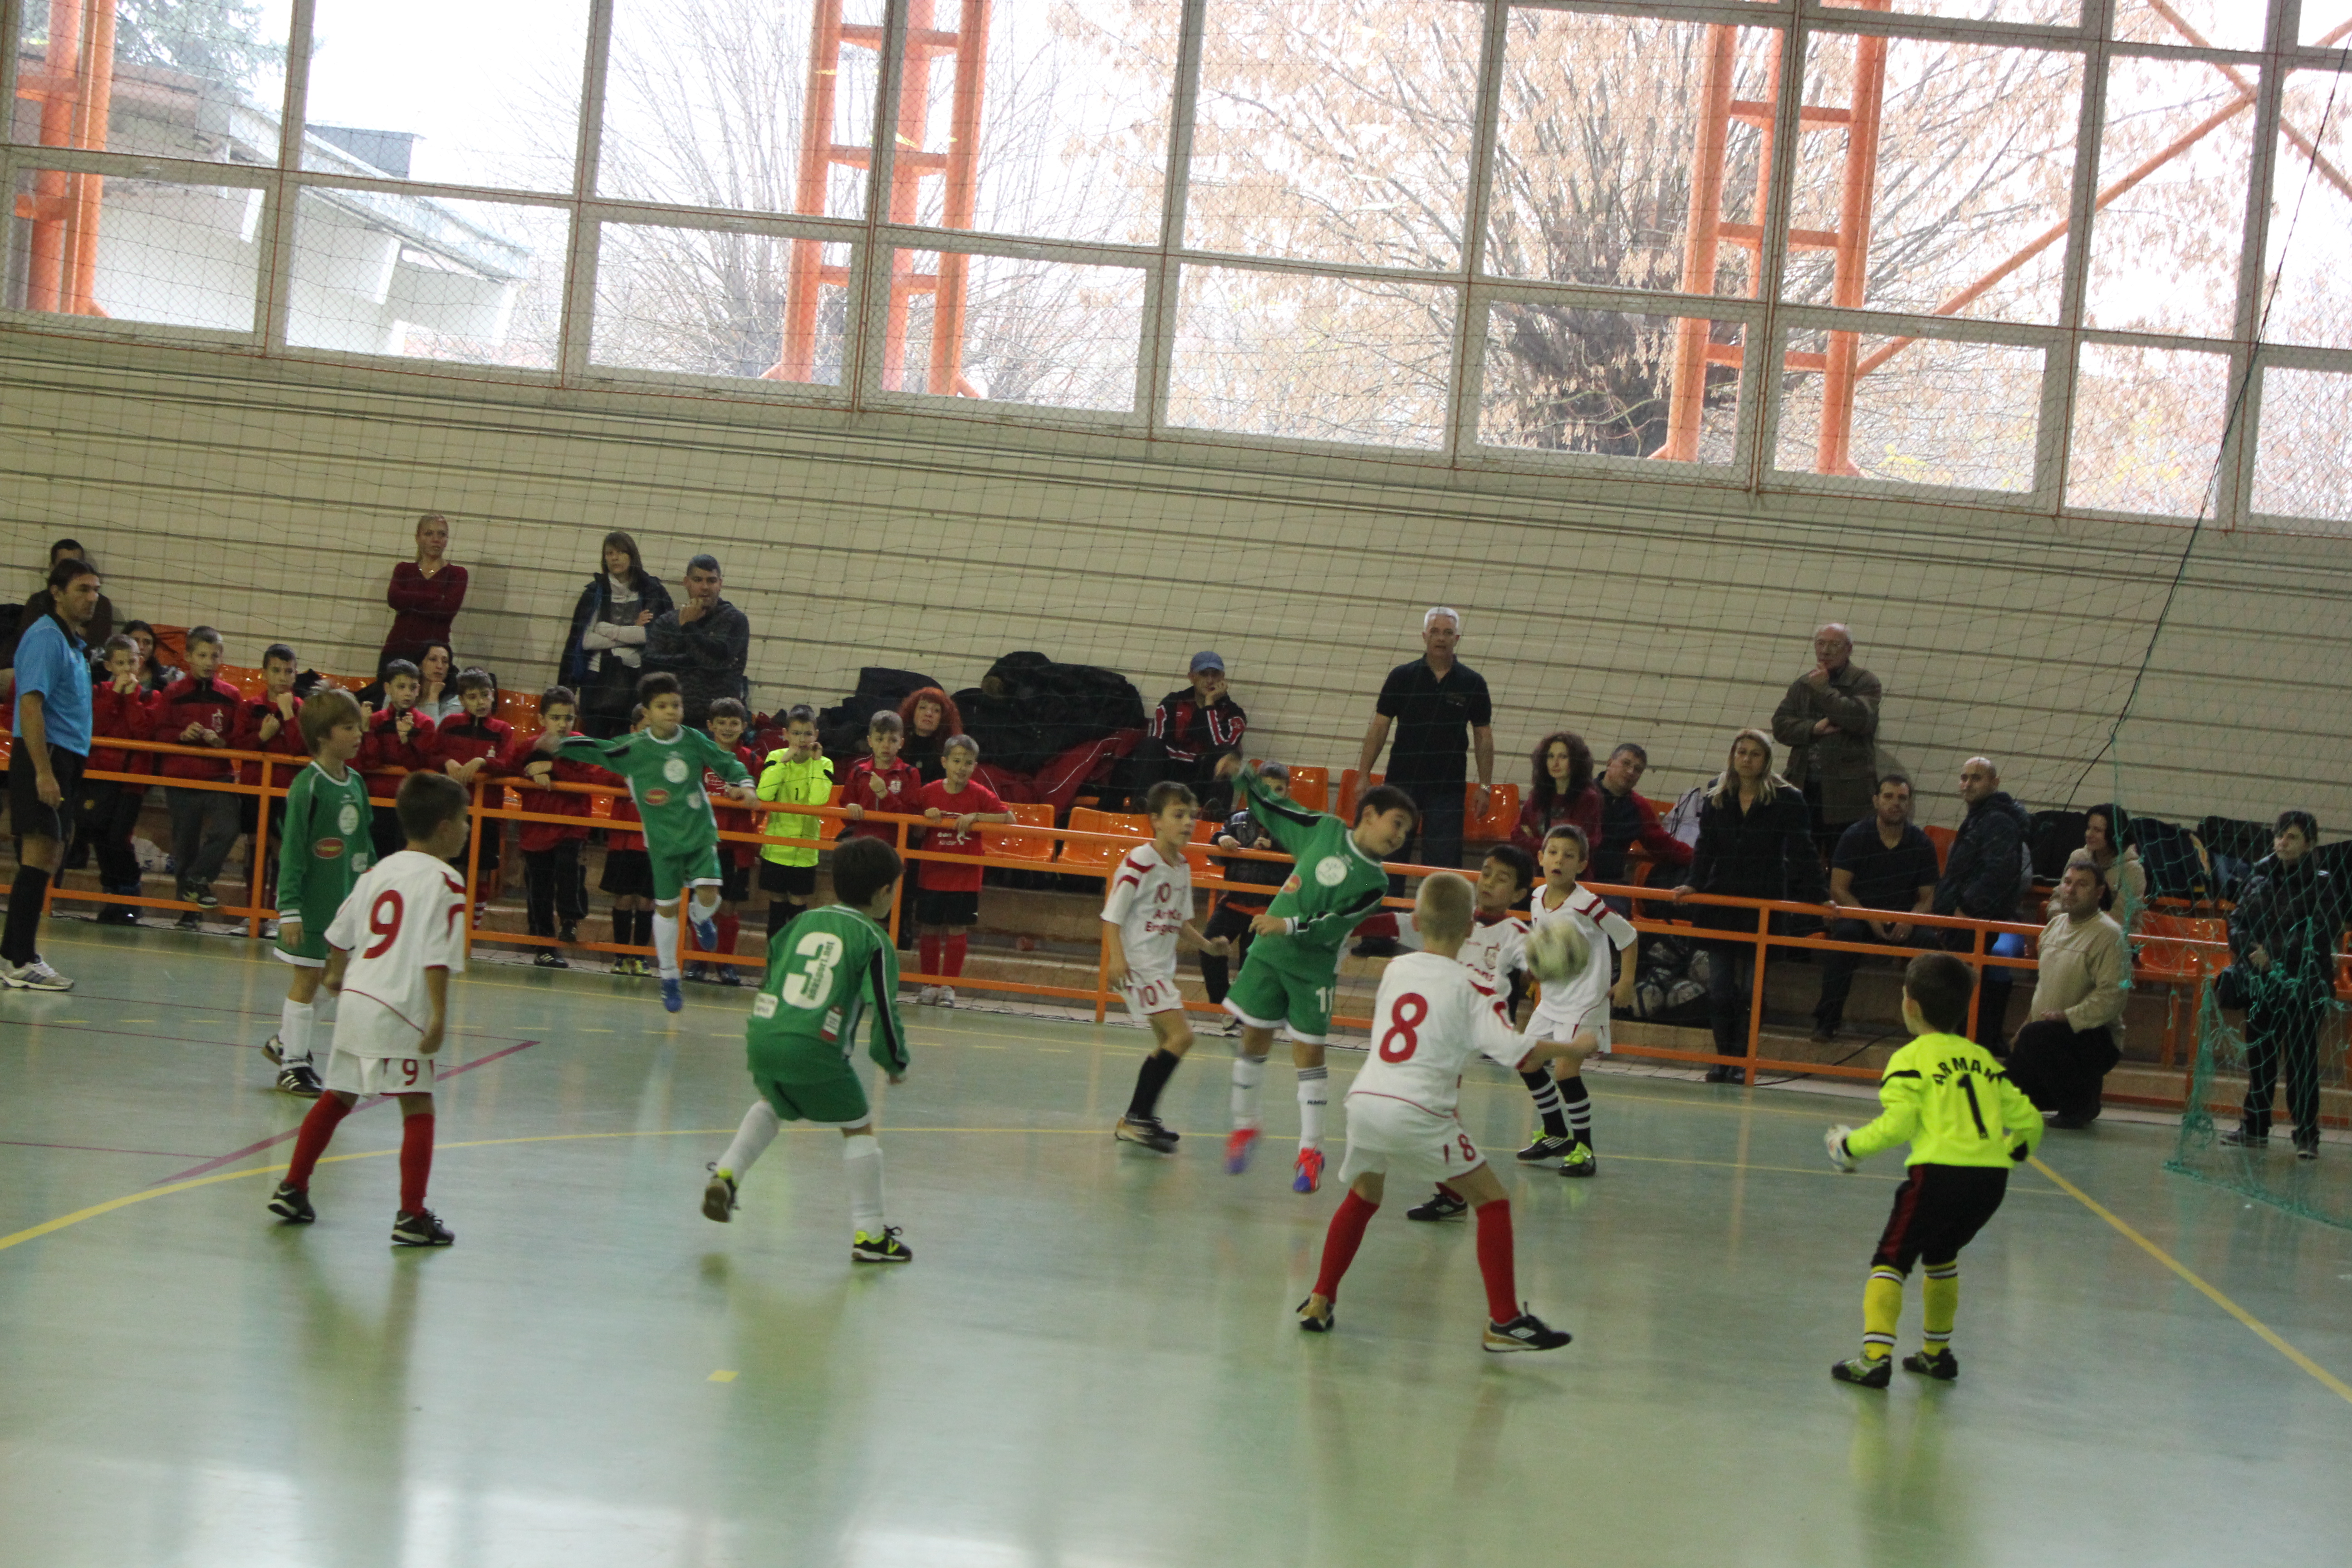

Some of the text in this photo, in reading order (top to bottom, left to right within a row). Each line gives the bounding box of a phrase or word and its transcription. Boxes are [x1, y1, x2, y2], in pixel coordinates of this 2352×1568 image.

[794, 788, 799, 800] 1
[363, 889, 403, 959] 9
[782, 931, 843, 1009] 3
[1137, 985, 1158, 1008] 10
[1379, 992, 1428, 1063] 8
[402, 1059, 418, 1086] 9
[1957, 1073, 1989, 1140] 1
[1458, 1134, 1476, 1161] 8
